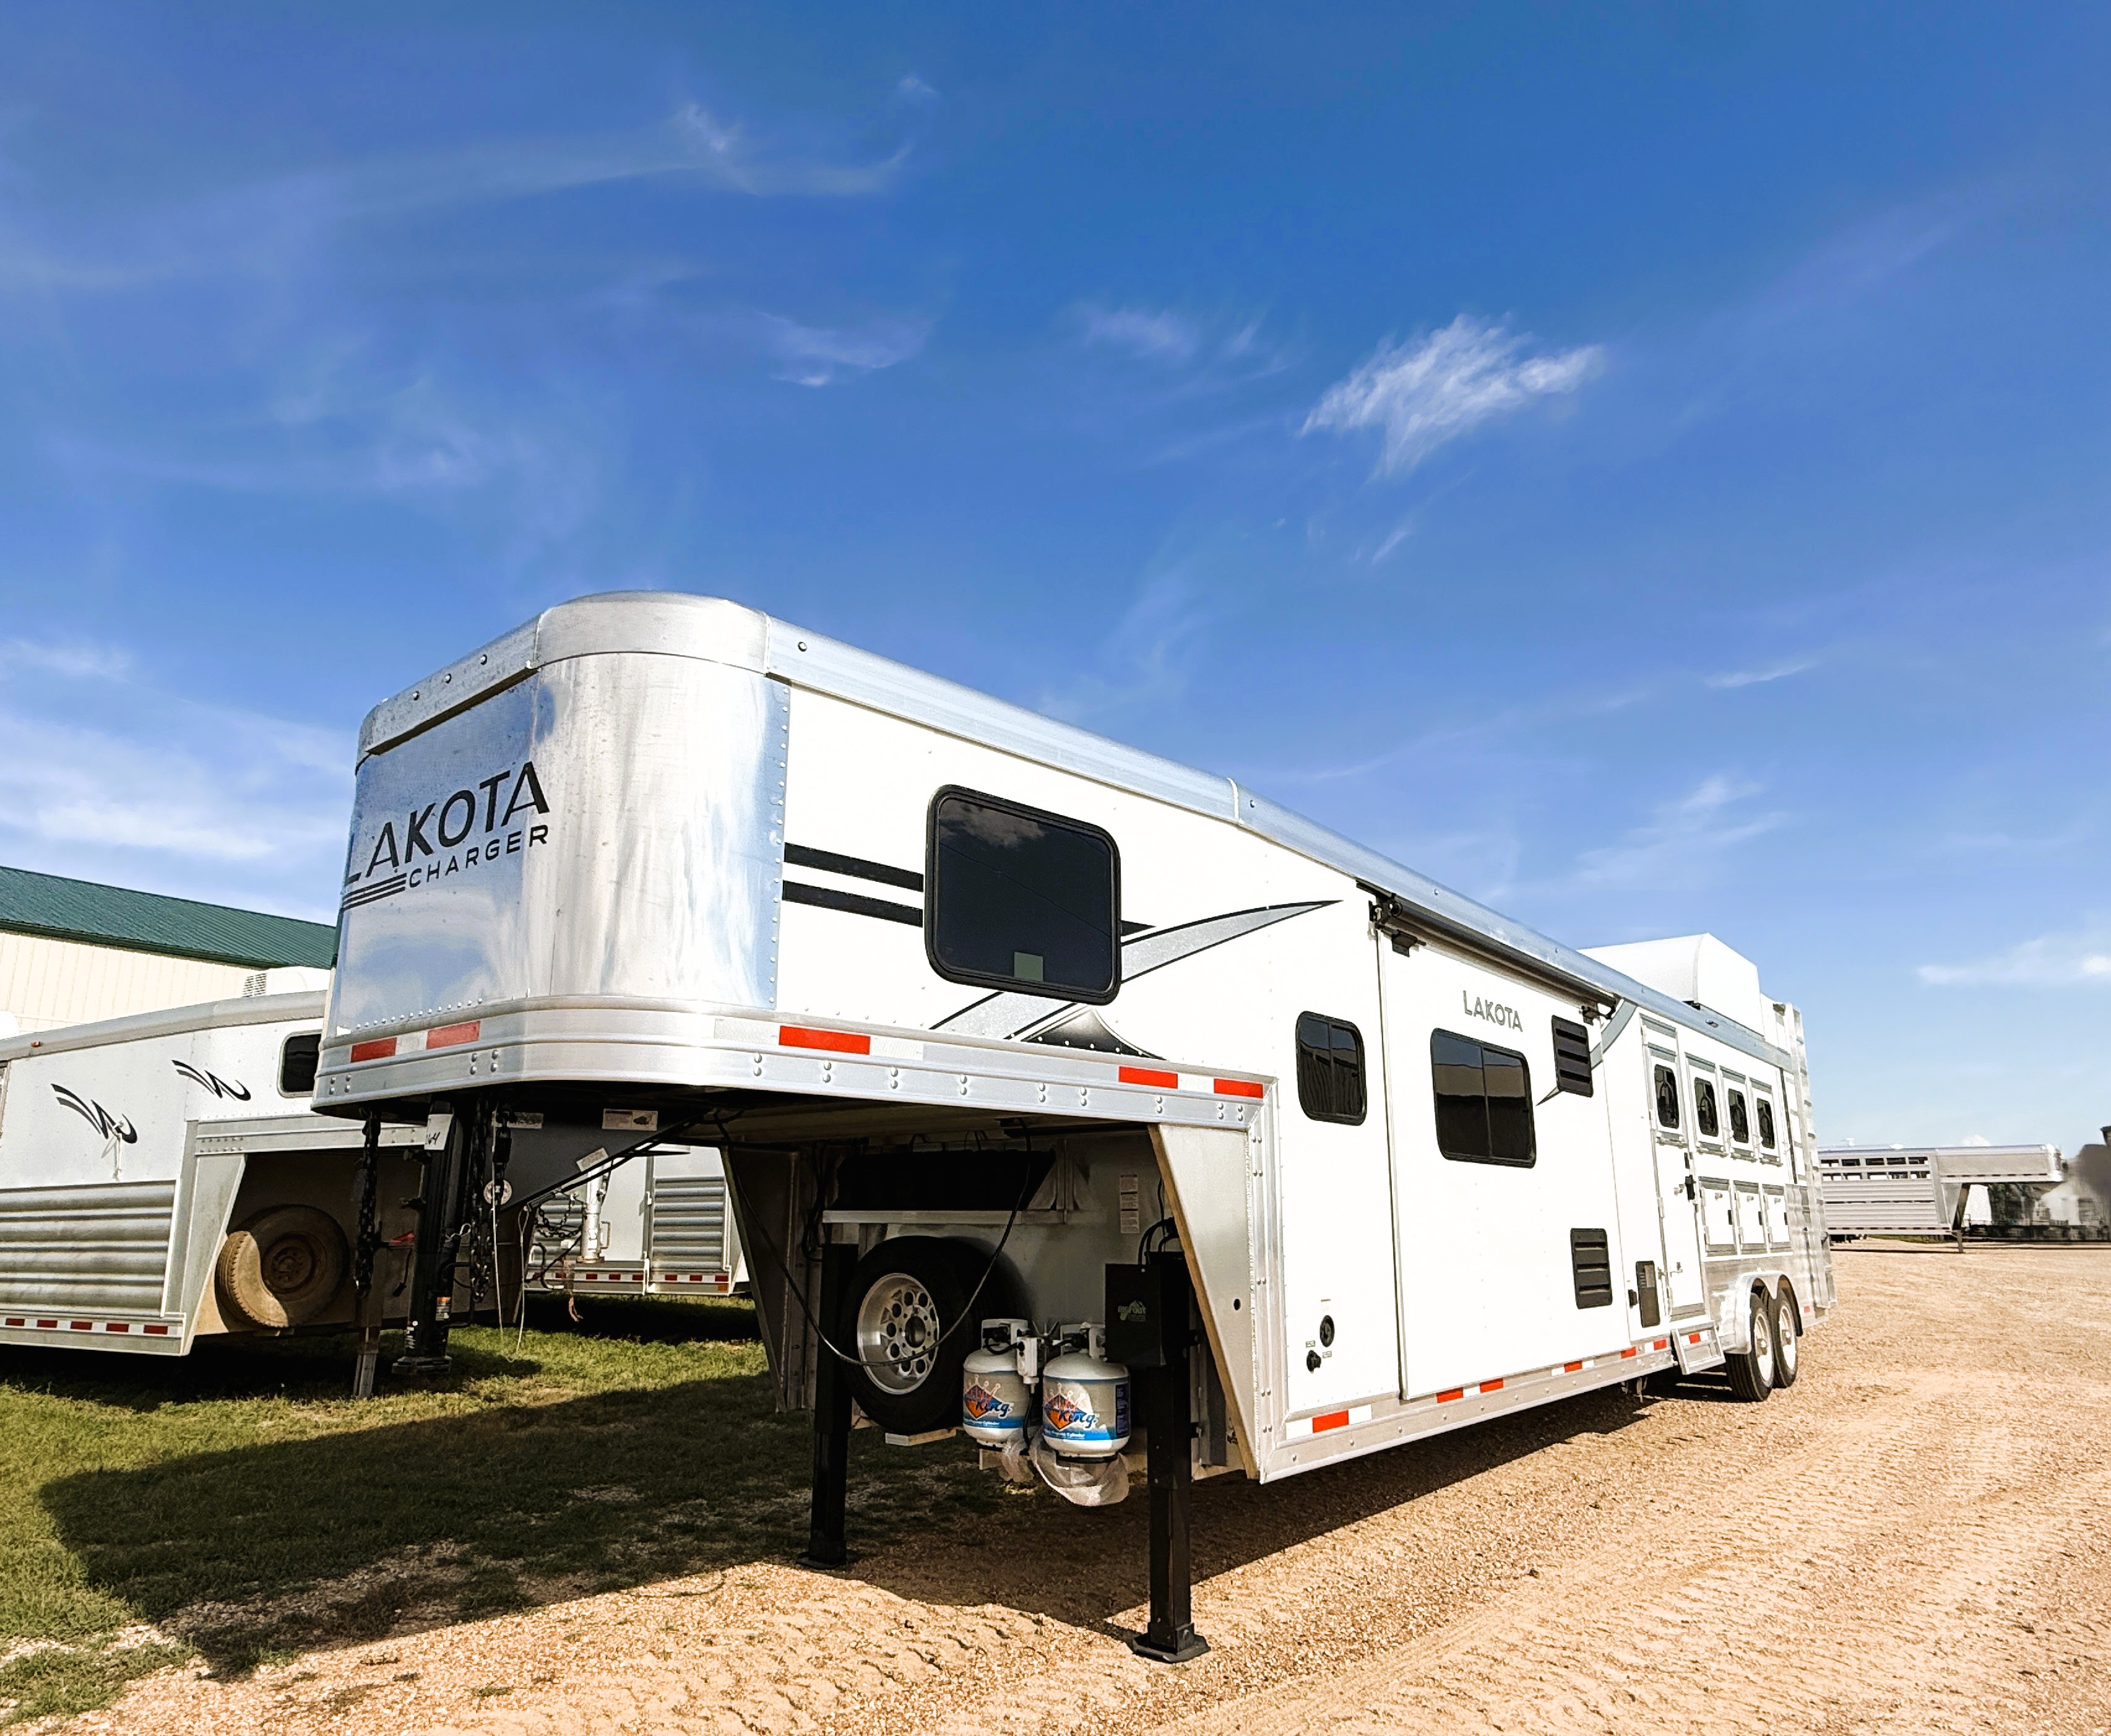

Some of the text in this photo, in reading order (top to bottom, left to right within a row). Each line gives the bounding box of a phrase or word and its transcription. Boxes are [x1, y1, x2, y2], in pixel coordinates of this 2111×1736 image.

[344, 761, 550, 886] LAKOTA
[409, 824, 549, 888] CHARGER
[1463, 990, 1523, 1032] LAKOTA
